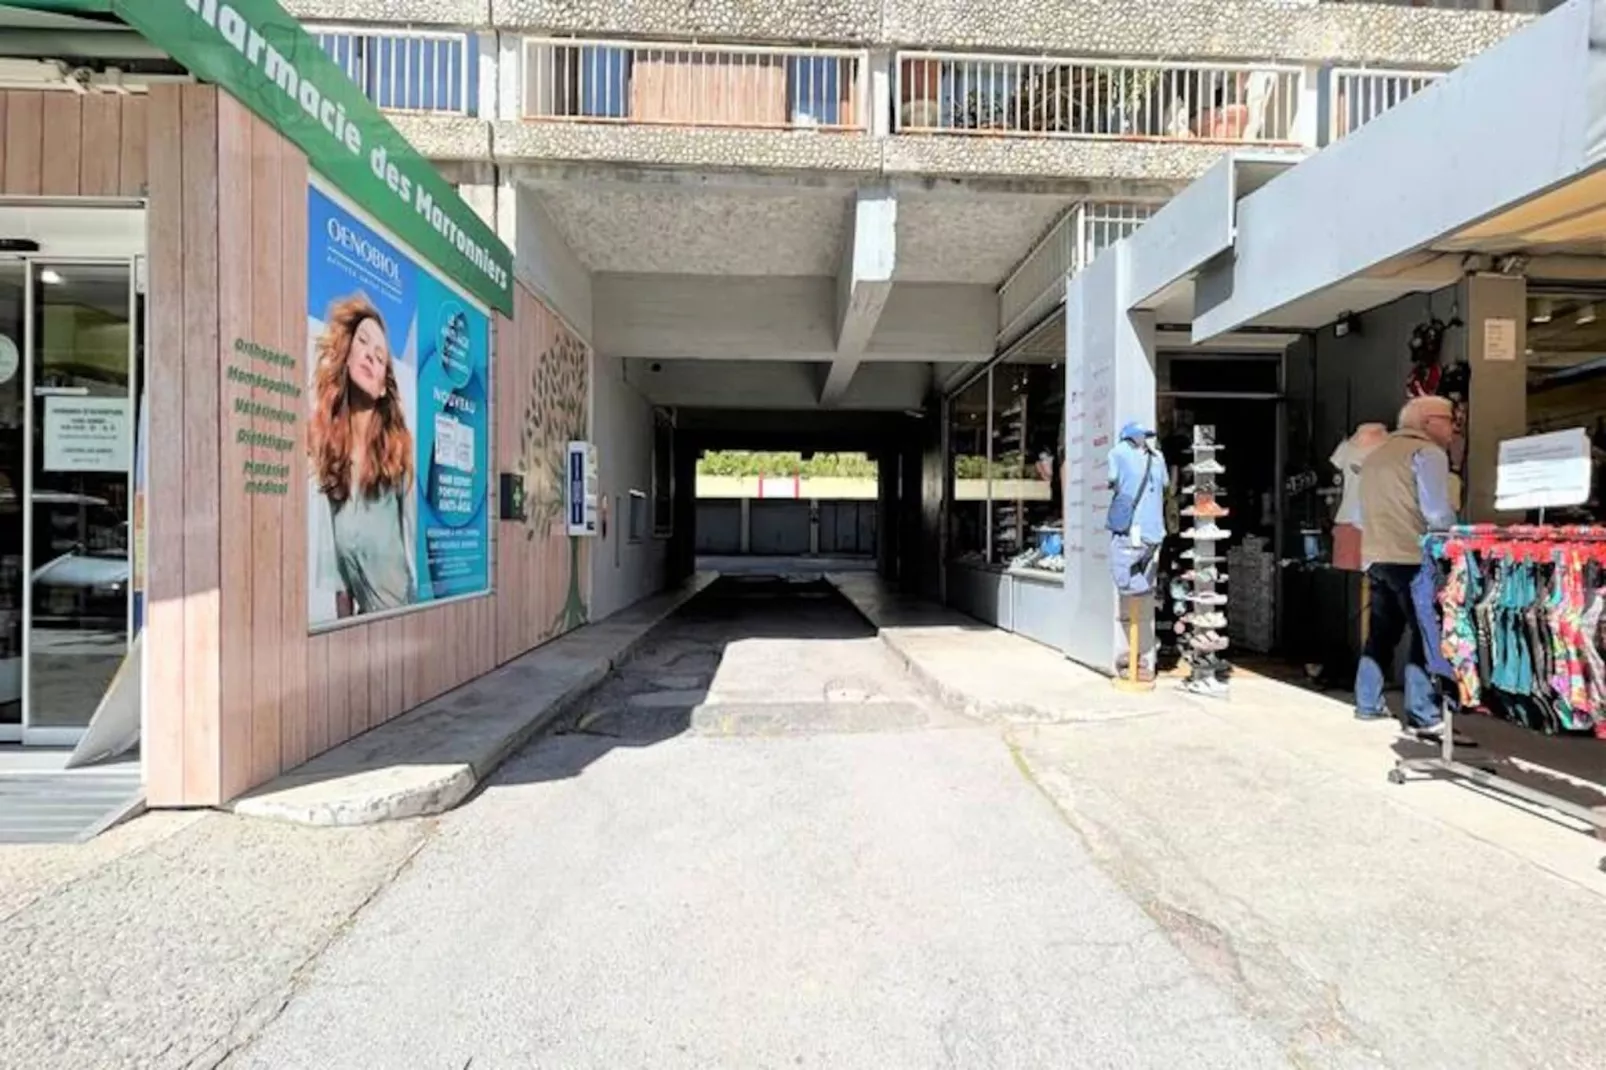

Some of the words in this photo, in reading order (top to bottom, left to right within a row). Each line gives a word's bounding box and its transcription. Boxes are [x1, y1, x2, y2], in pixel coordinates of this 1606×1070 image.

[327, 217, 402, 286] OENOBIOL
[371, 145, 411, 204] des
[415, 184, 508, 291] Marronniers
